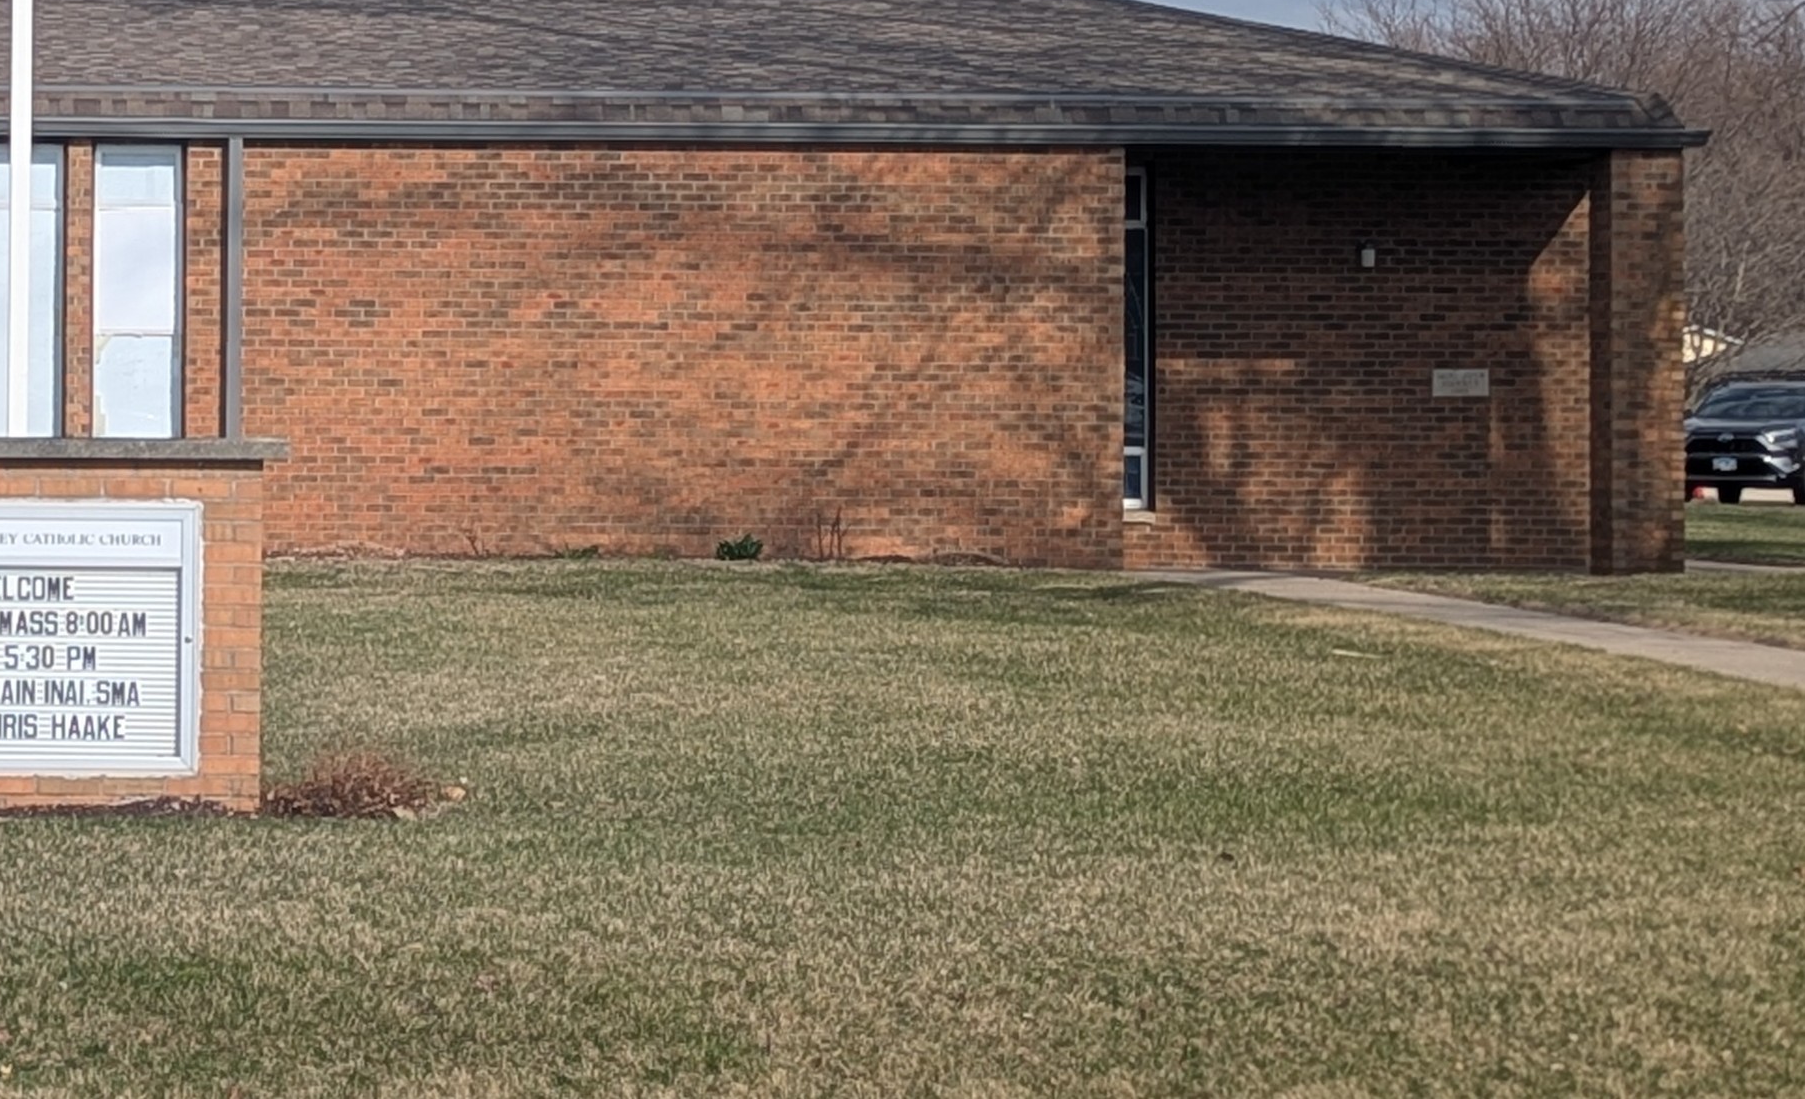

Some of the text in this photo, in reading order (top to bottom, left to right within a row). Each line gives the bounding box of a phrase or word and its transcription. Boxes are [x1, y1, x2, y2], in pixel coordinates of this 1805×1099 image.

[23, 534, 95, 546] CATHOLIC
[99, 534, 162, 547] CHURCH
[0, 611, 58, 635] MASS
[66, 611, 113, 635] 8:00
[117, 612, 146, 637] AM
[4, 644, 55, 670] 5:30
[67, 646, 96, 670] PM
[96, 680, 140, 706] SMA
[52, 714, 125, 740] HAAKE
